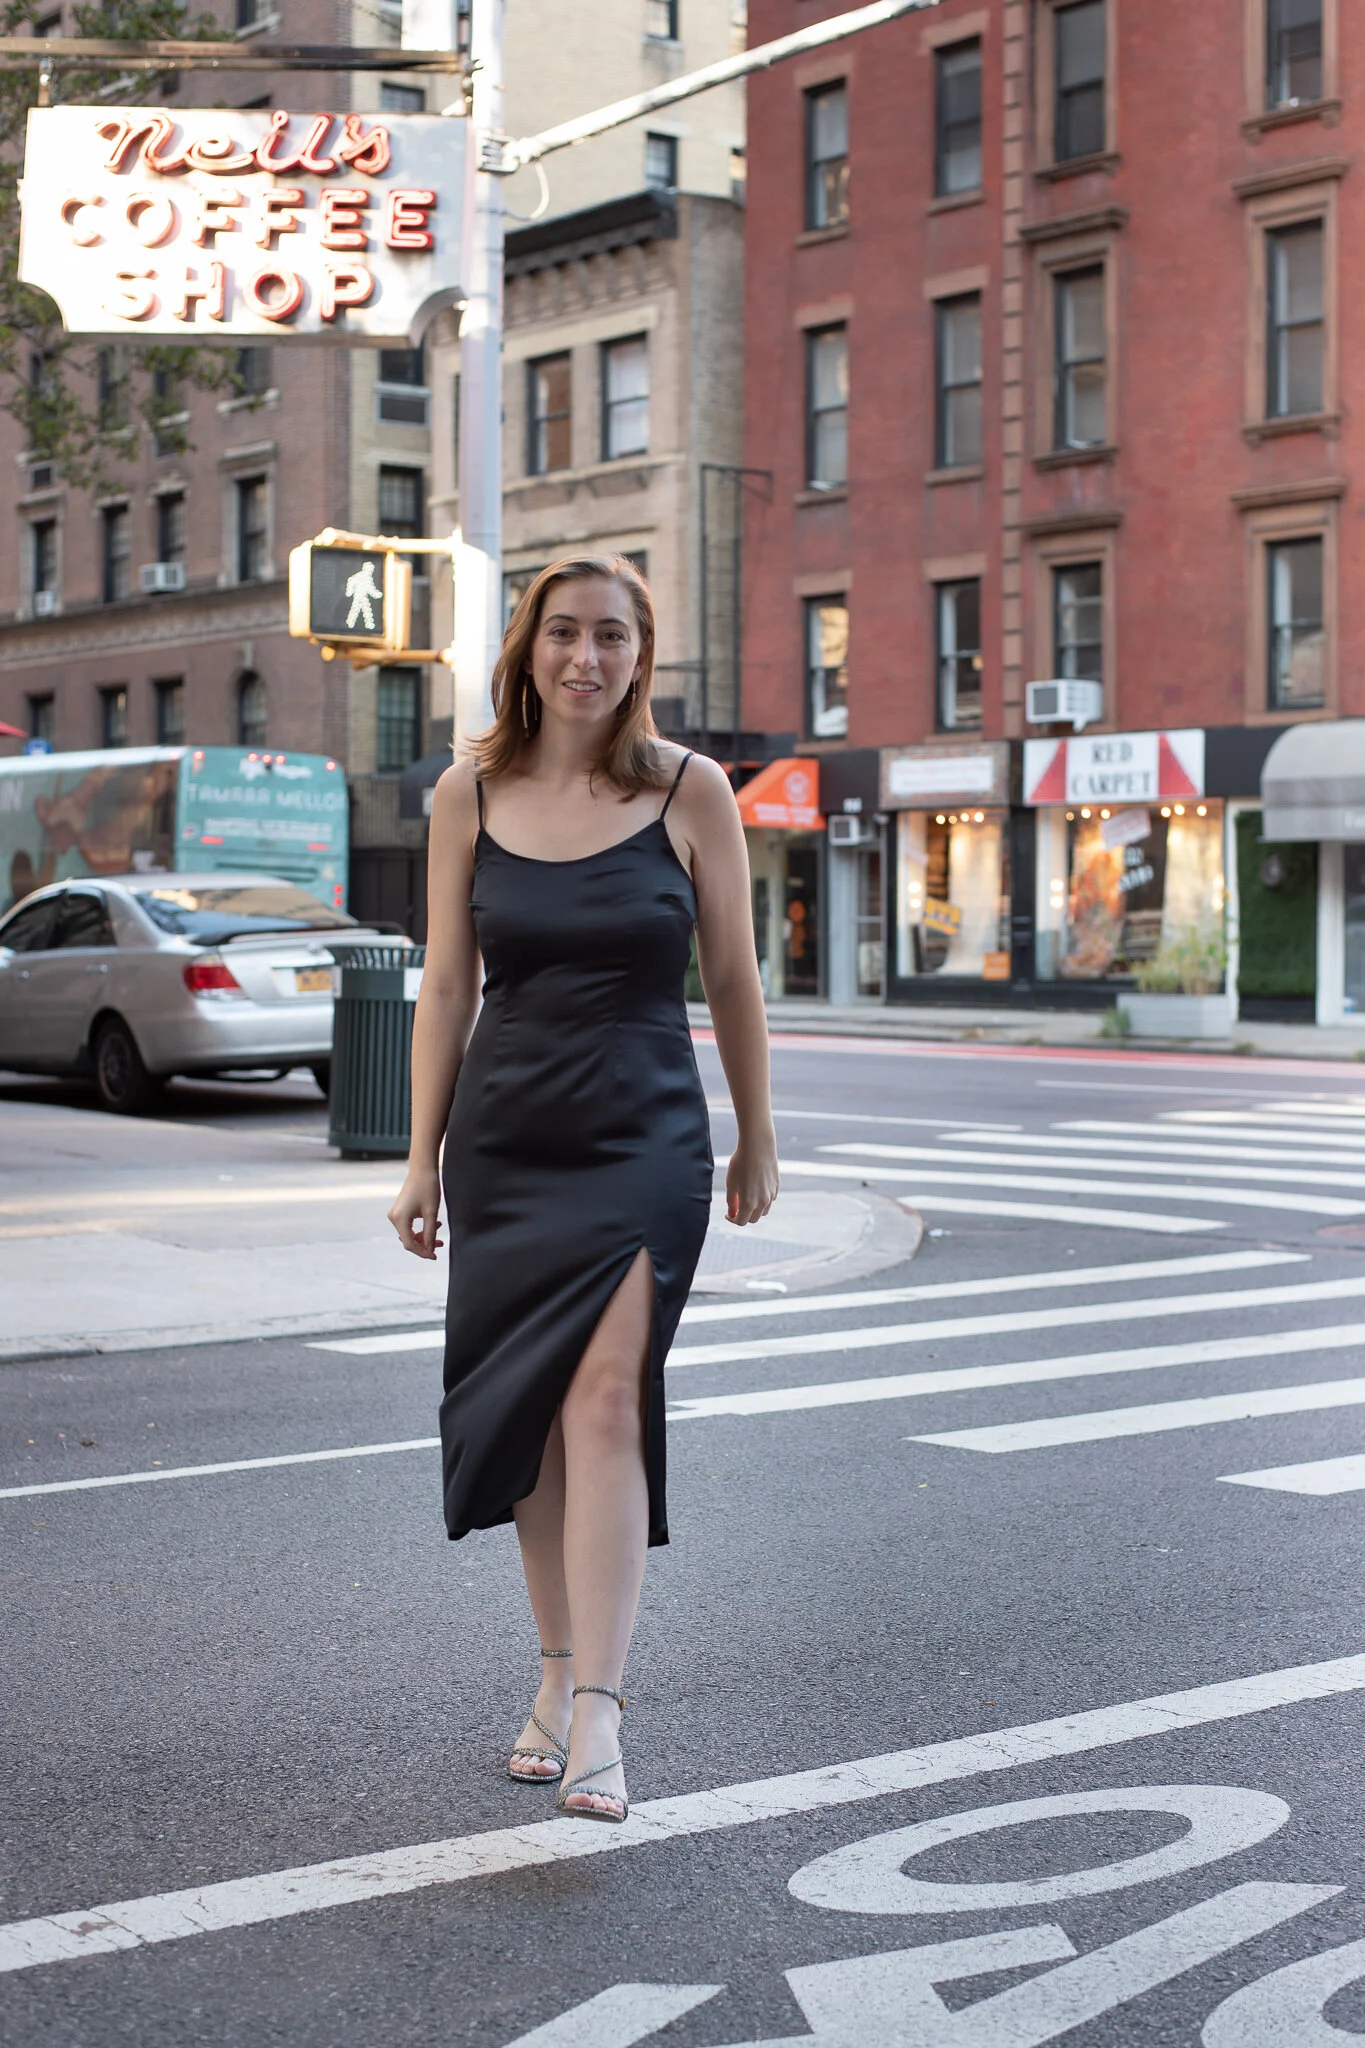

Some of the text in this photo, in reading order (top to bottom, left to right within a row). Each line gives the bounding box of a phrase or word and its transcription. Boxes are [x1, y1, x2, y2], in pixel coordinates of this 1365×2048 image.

[61, 188, 435, 249] COFFEE
[103, 261, 375, 320] SHOP
[1091, 741, 1132, 765] RED
[1071, 771, 1153, 796] CARPET
